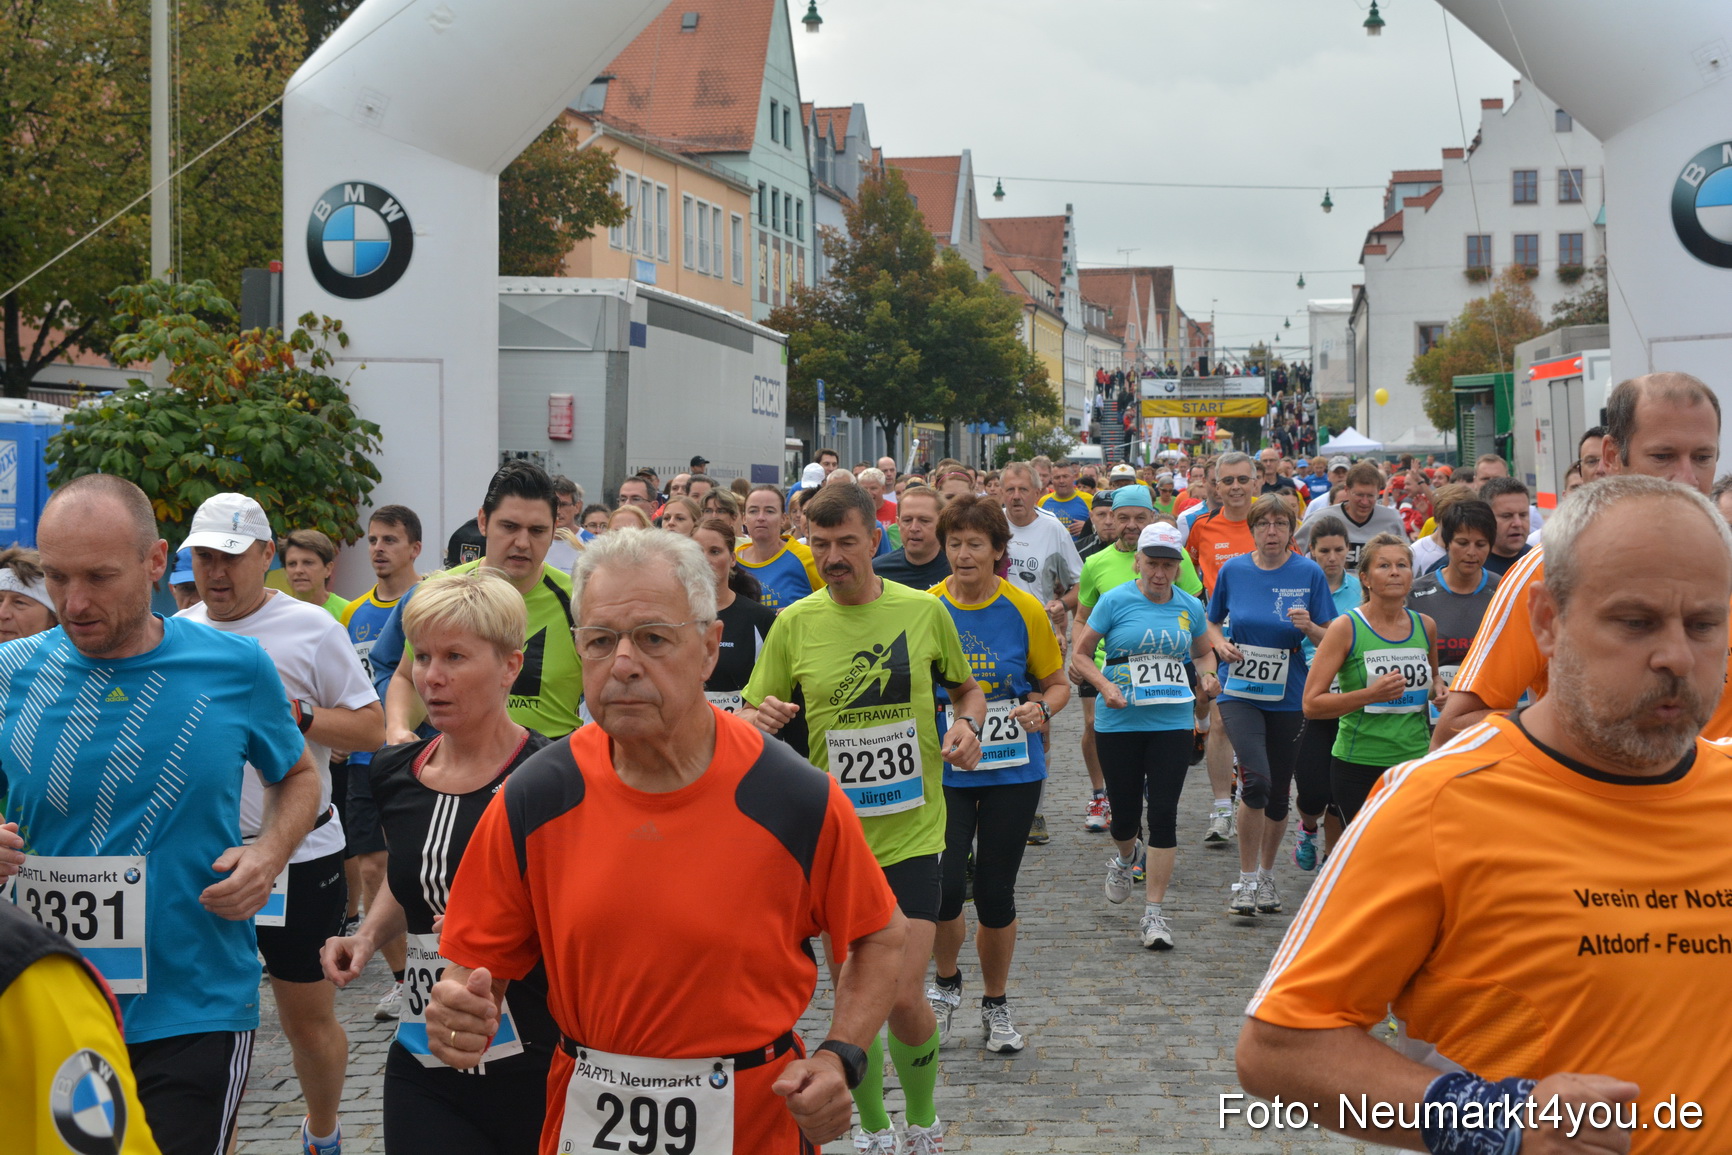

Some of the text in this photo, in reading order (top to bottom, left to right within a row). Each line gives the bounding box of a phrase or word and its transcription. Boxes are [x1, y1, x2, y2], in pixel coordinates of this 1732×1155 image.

[313, 184, 405, 223] BMW
[752, 375, 780, 418] BOCK
[1182, 402, 1226, 413] START
[1251, 651, 1279, 660] Neumarkt
[1366, 654, 1421, 664] PARTL Neumarkt
[1137, 662, 1184, 684] 2142
[1234, 659, 1283, 681] 2267
[829, 661, 867, 706] GOSSEN
[1145, 687, 1183, 697] Hannelore
[1246, 683, 1264, 693] Anni
[838, 707, 912, 724] METRAWATT
[829, 731, 904, 748] PARTL Neumarkt
[838, 742, 915, 784] 2238
[859, 788, 902, 806] Jürgen
[18, 866, 47, 882] PARTL
[50, 871, 118, 883] Neumarkt
[1573, 888, 1640, 908] Verein
[1645, 889, 1678, 909] der
[26, 888, 124, 941] 3331
[1577, 932, 1650, 956] Altdorf
[576, 1062, 616, 1084] PARTL
[620, 1073, 702, 1088] Neumarkt
[592, 1092, 697, 1155] 299
